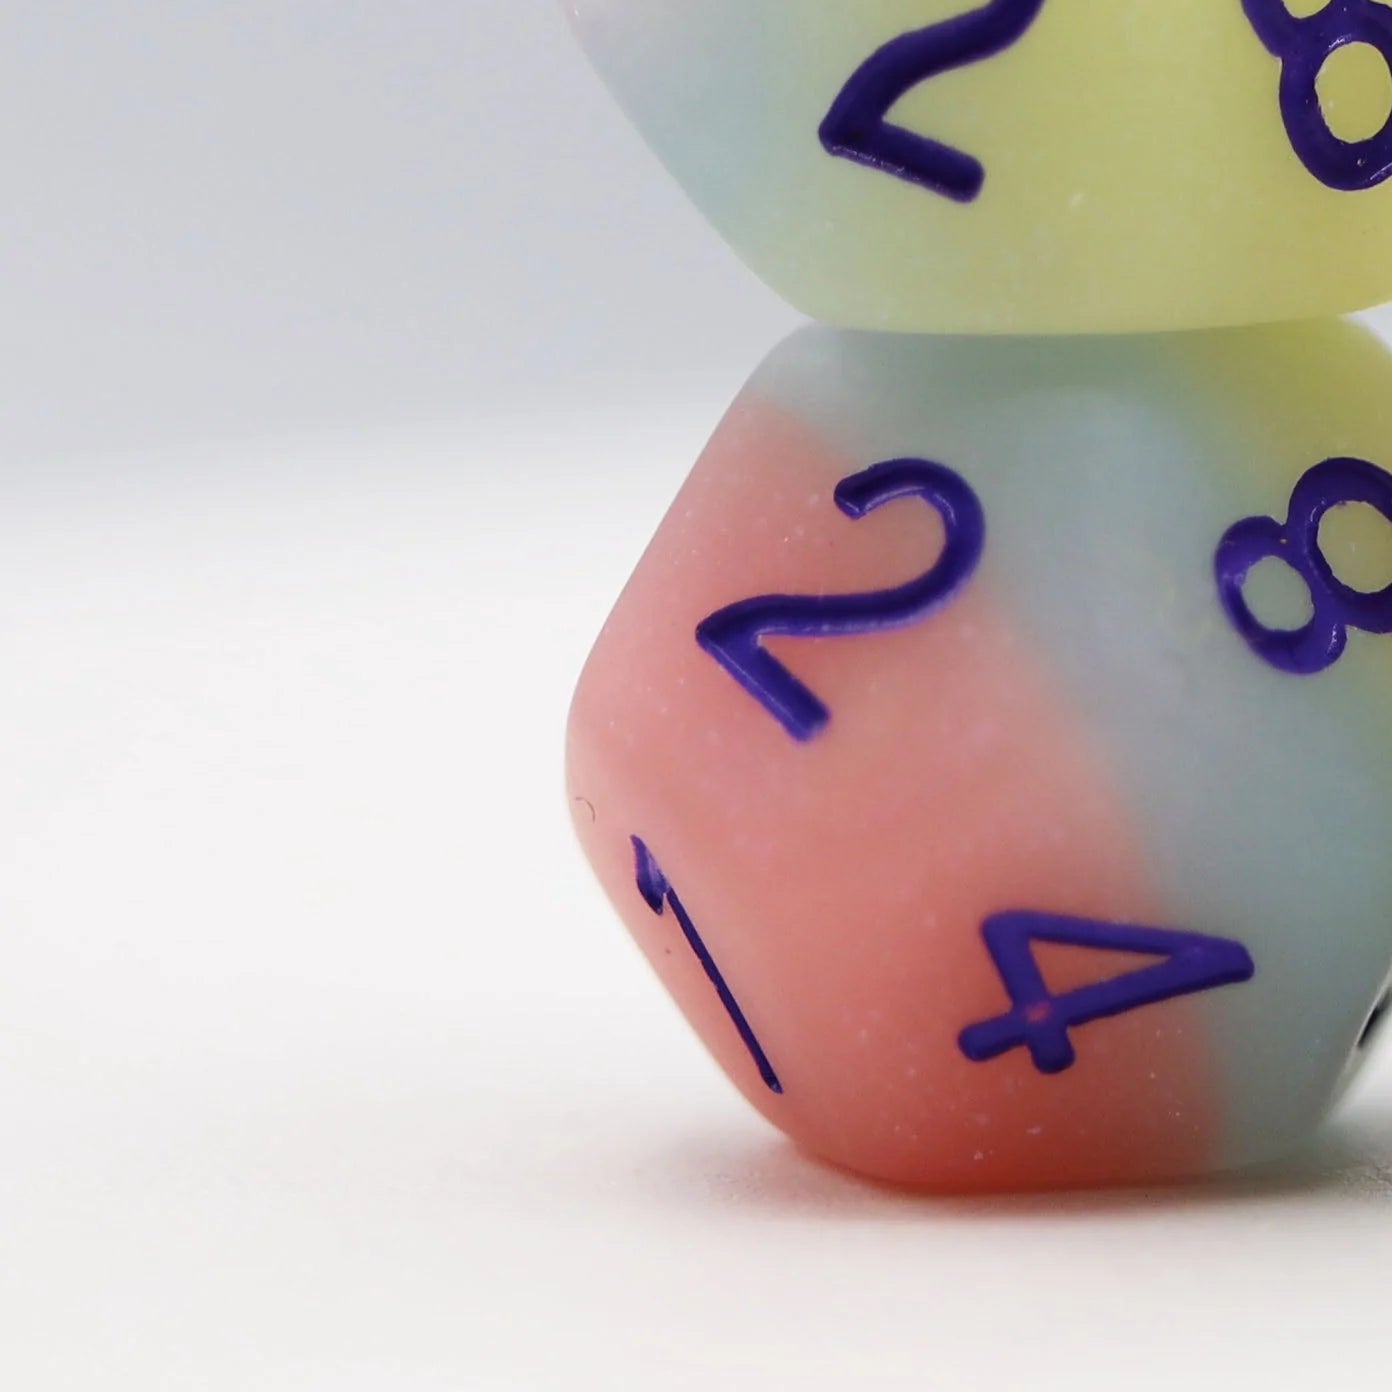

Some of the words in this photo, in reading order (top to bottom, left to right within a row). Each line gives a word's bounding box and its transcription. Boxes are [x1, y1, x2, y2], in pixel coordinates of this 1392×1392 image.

[693, 456, 987, 745] 2
[628, 832, 785, 1096] 1
[956, 908, 1257, 1075] 4
